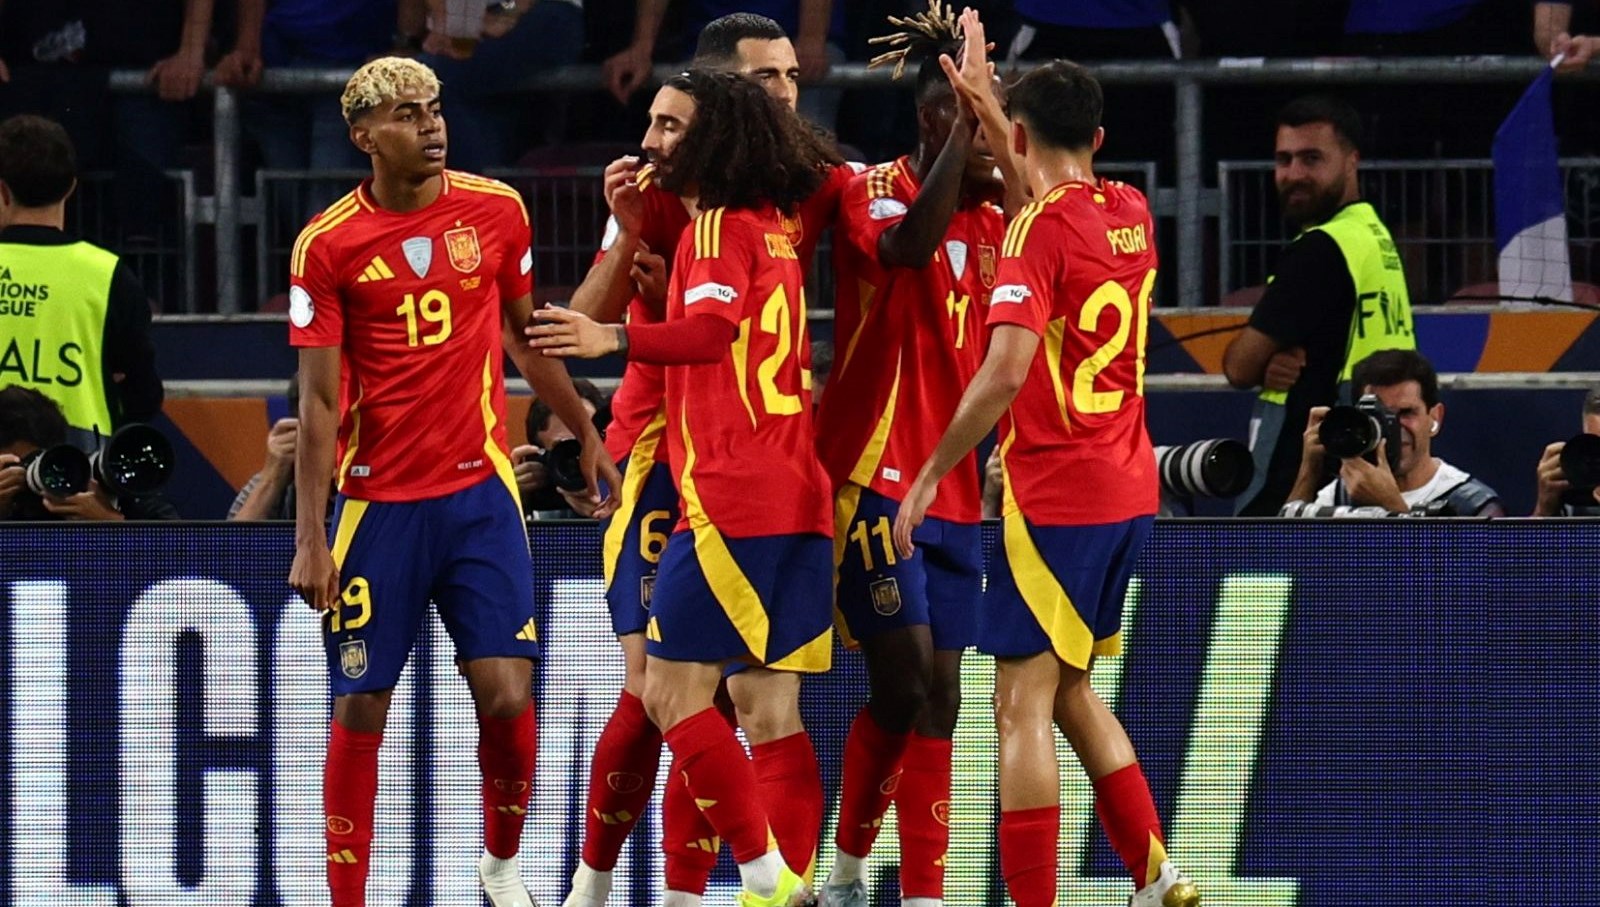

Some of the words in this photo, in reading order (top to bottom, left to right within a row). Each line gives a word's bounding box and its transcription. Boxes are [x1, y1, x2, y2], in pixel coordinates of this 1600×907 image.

[1106, 223, 1147, 255] PEDRI
[0, 265, 12, 281] A
[0, 283, 49, 301] IONS
[396, 289, 452, 347] 19
[640, 510, 671, 563] 6
[850, 516, 896, 571] 11
[331, 576, 372, 633] 19
